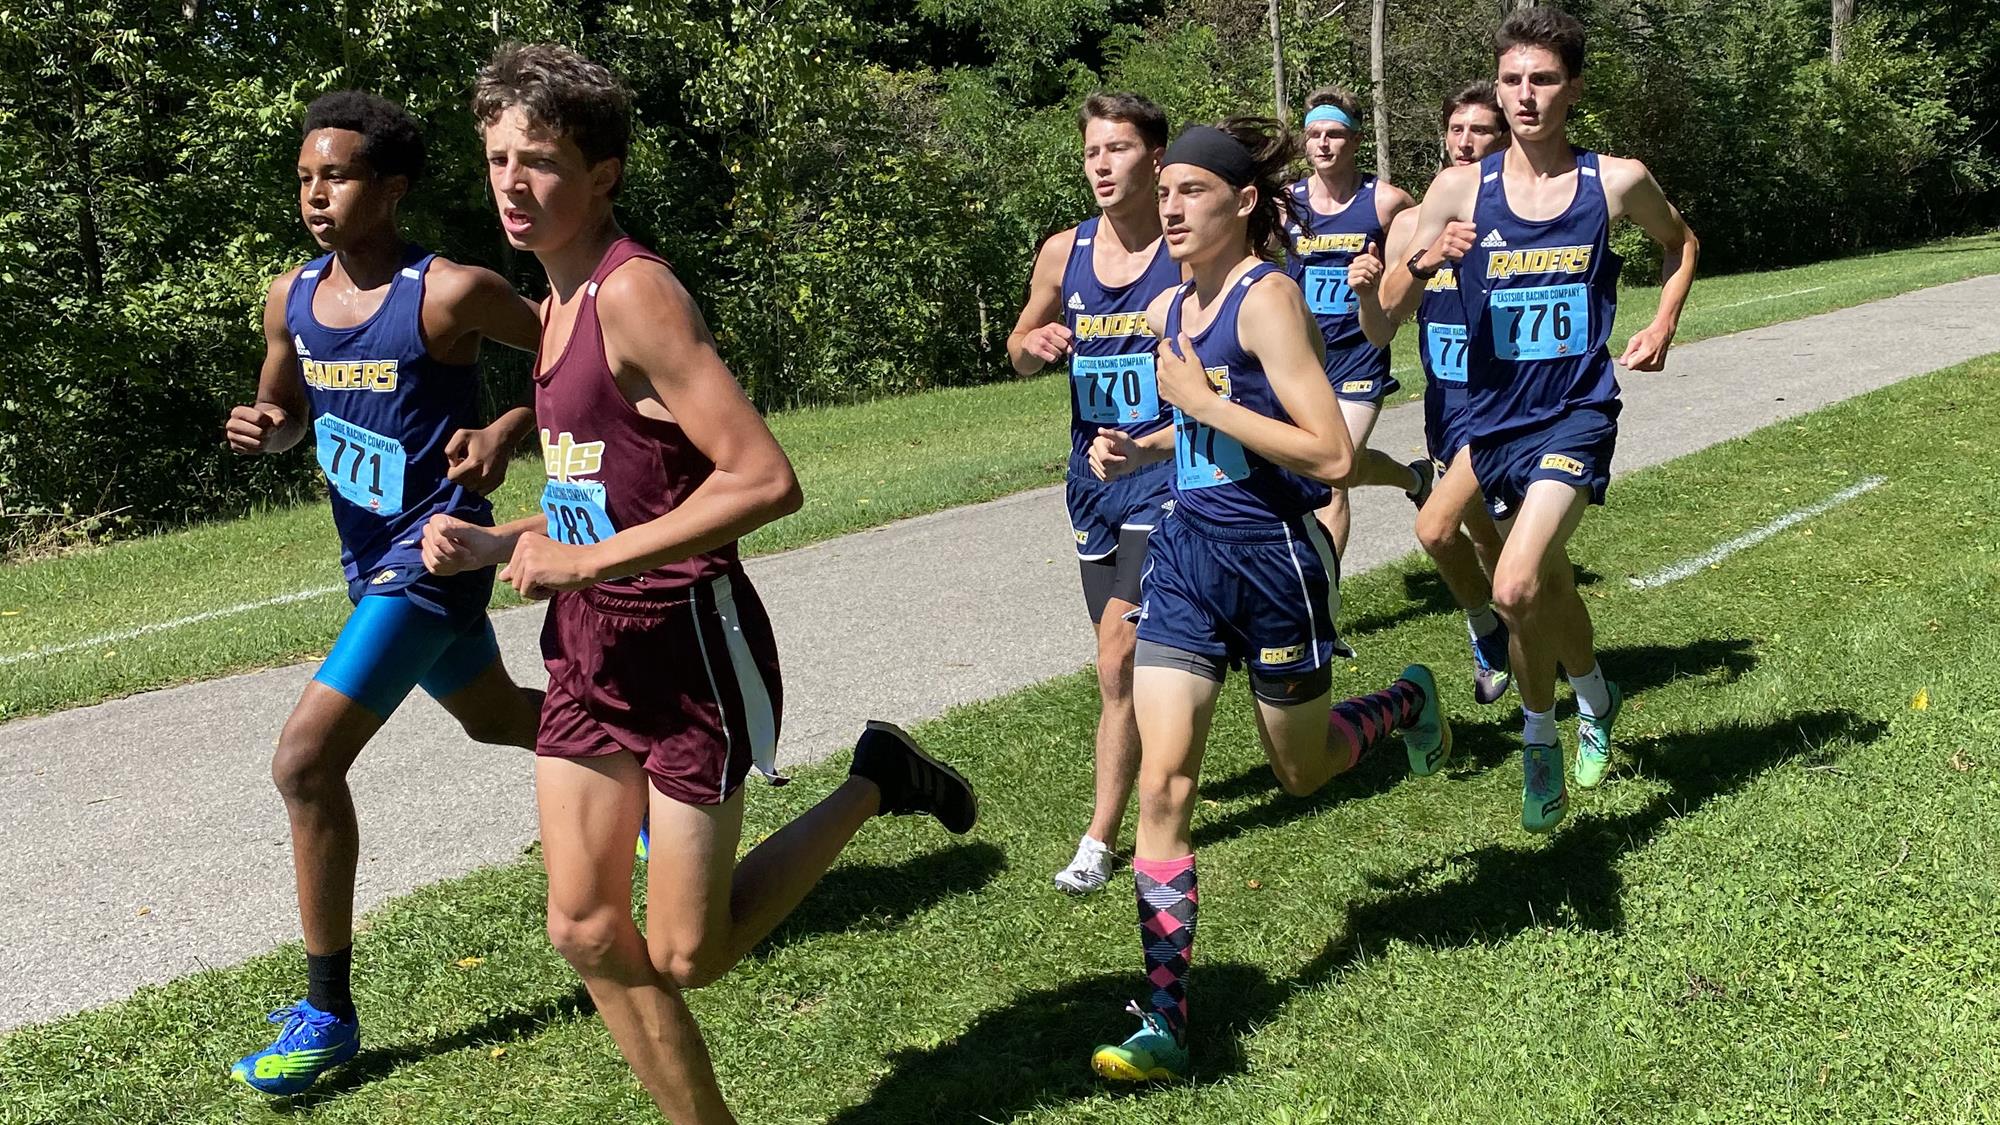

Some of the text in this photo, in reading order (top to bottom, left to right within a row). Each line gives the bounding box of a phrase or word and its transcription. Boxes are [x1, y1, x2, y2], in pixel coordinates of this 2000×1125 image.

[1481, 240, 1507, 248] adidas
[1487, 245, 1594, 280] RAIDERS
[1497, 287, 1580, 303] EASTSIDE RACING COMPANY
[1075, 311, 1156, 341] RAIDER
[1507, 302, 1572, 344] 776
[1119, 357, 1148, 368] COMPANY
[1439, 337, 1468, 368] 77
[1085, 370, 1141, 407] 770
[320, 418, 400, 455] EASTSIDE RACING COMPANY
[330, 433, 384, 497] 771
[547, 502, 600, 545] 783
